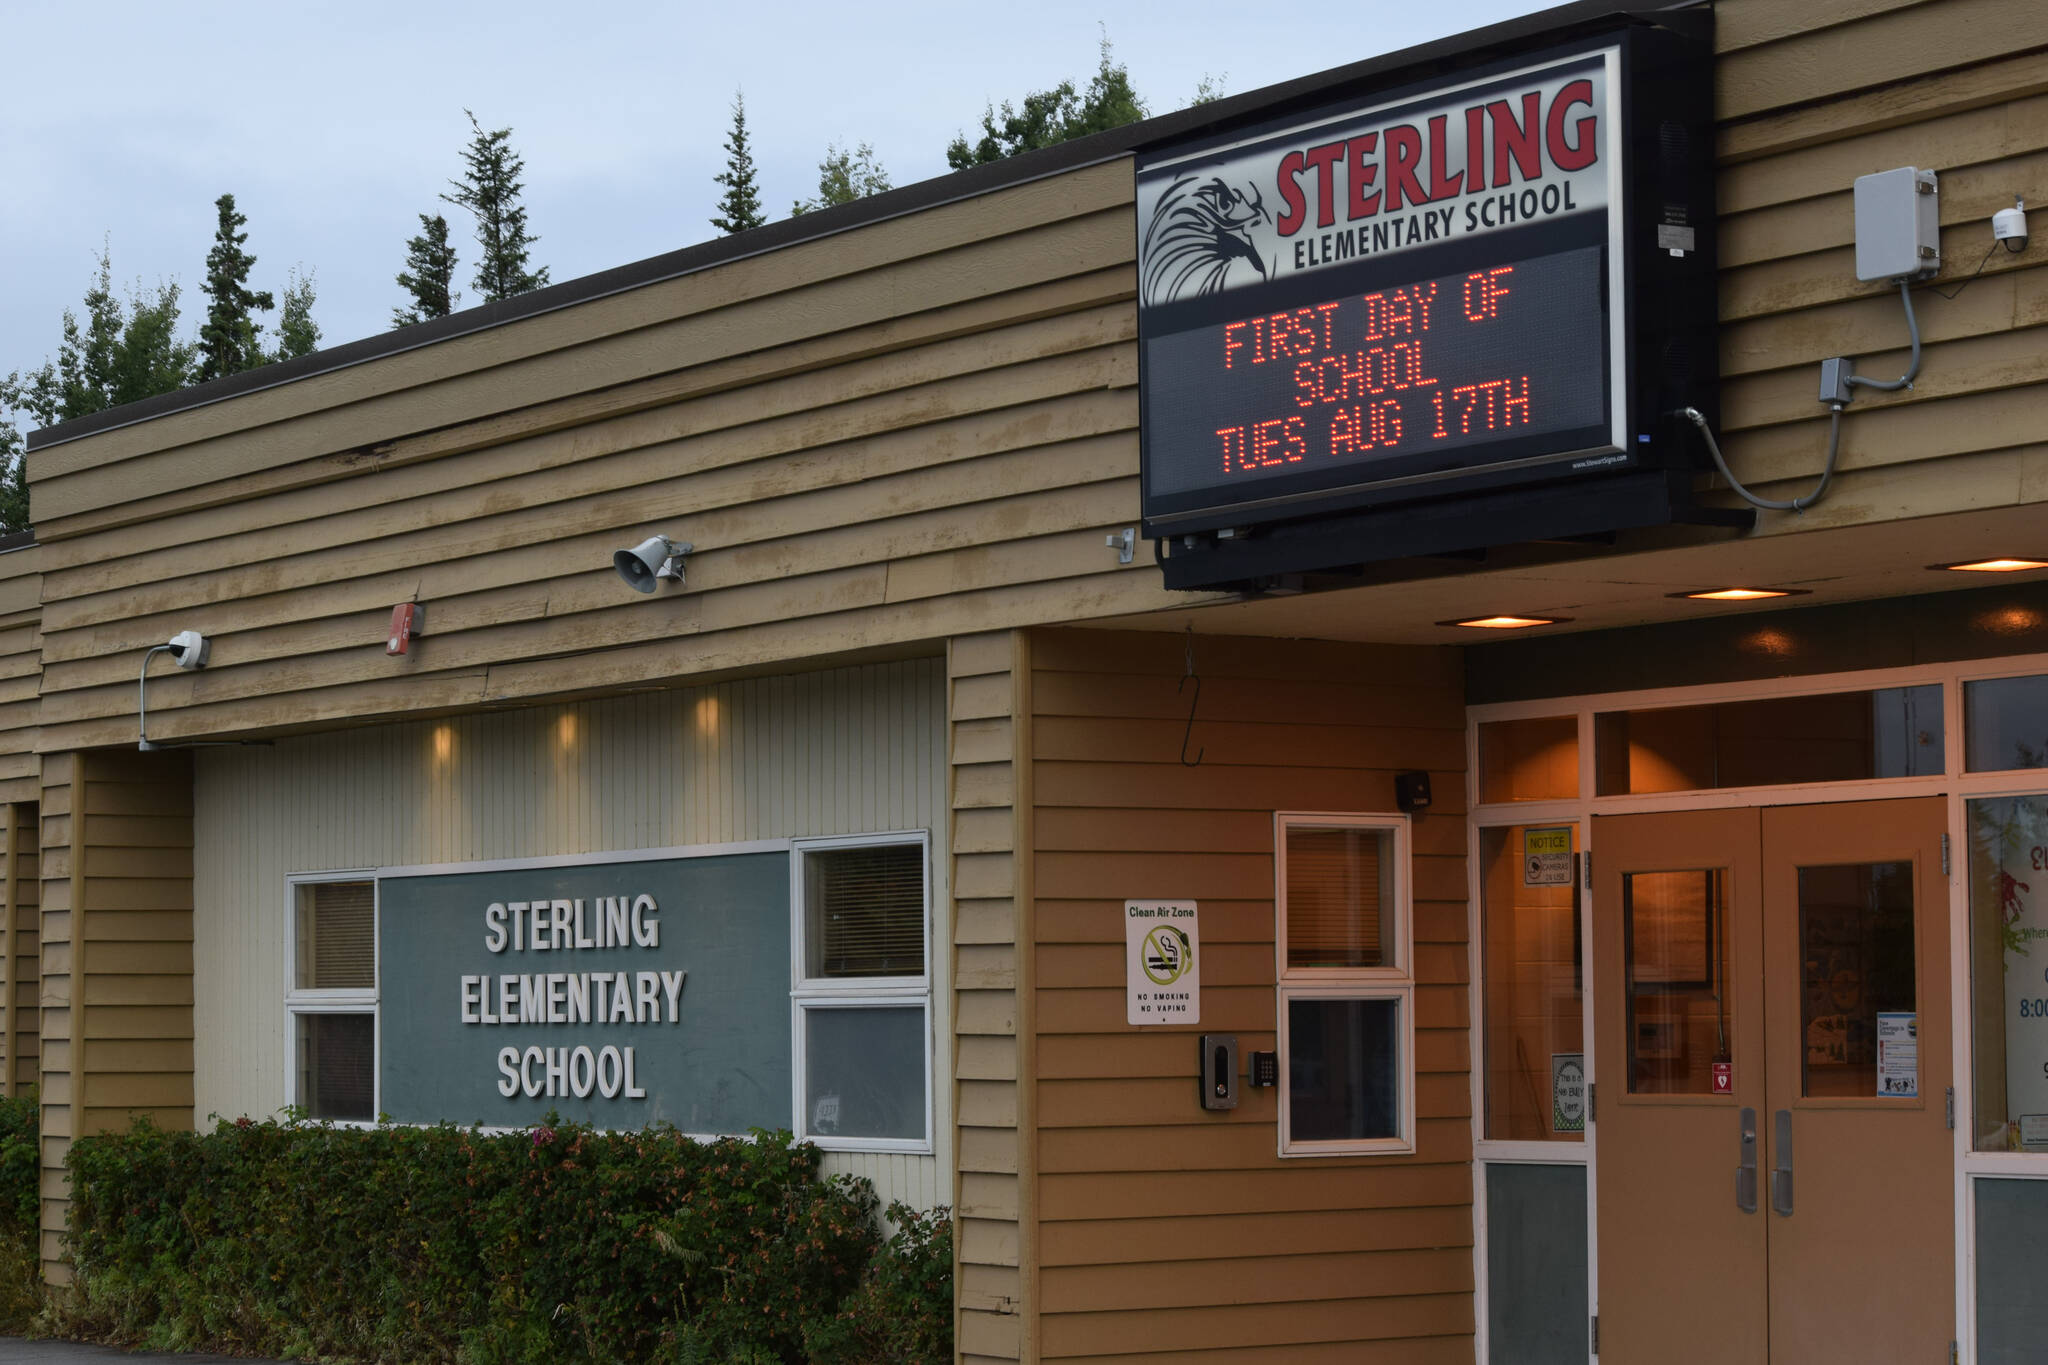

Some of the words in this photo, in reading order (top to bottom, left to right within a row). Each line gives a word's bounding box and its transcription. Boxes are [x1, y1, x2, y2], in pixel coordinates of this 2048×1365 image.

[1276, 79, 1598, 237] STERLING
[1294, 206, 1455, 270] ELEMENTARY
[1465, 180, 1577, 233] SCHOOL
[1223, 302, 1340, 369] FIRST
[1364, 281, 1438, 343] DAY
[1463, 266, 1514, 323] OF
[1295, 340, 1438, 408] SCHOOL
[1215, 415, 1308, 474] TUES
[1329, 399, 1403, 456] AUG
[1431, 375, 1531, 439] 17TH
[1530, 837, 1565, 849] NOTICE
[1542, 863, 1569, 871] CAMERAS
[485, 893, 660, 953] STERLING
[1129, 906, 1155, 918] Clean
[1157, 906, 1169, 918] Air
[1171, 906, 1195, 918] Zone
[460, 970, 687, 1025] ELEMENTARY
[1137, 993, 1148, 1001] NO
[1154, 992, 1190, 1000] SMOKING
[1141, 1004, 1151, 1012] NO
[1157, 1004, 1186, 1012] VAPING
[497, 1044, 647, 1098] SCHOOL
